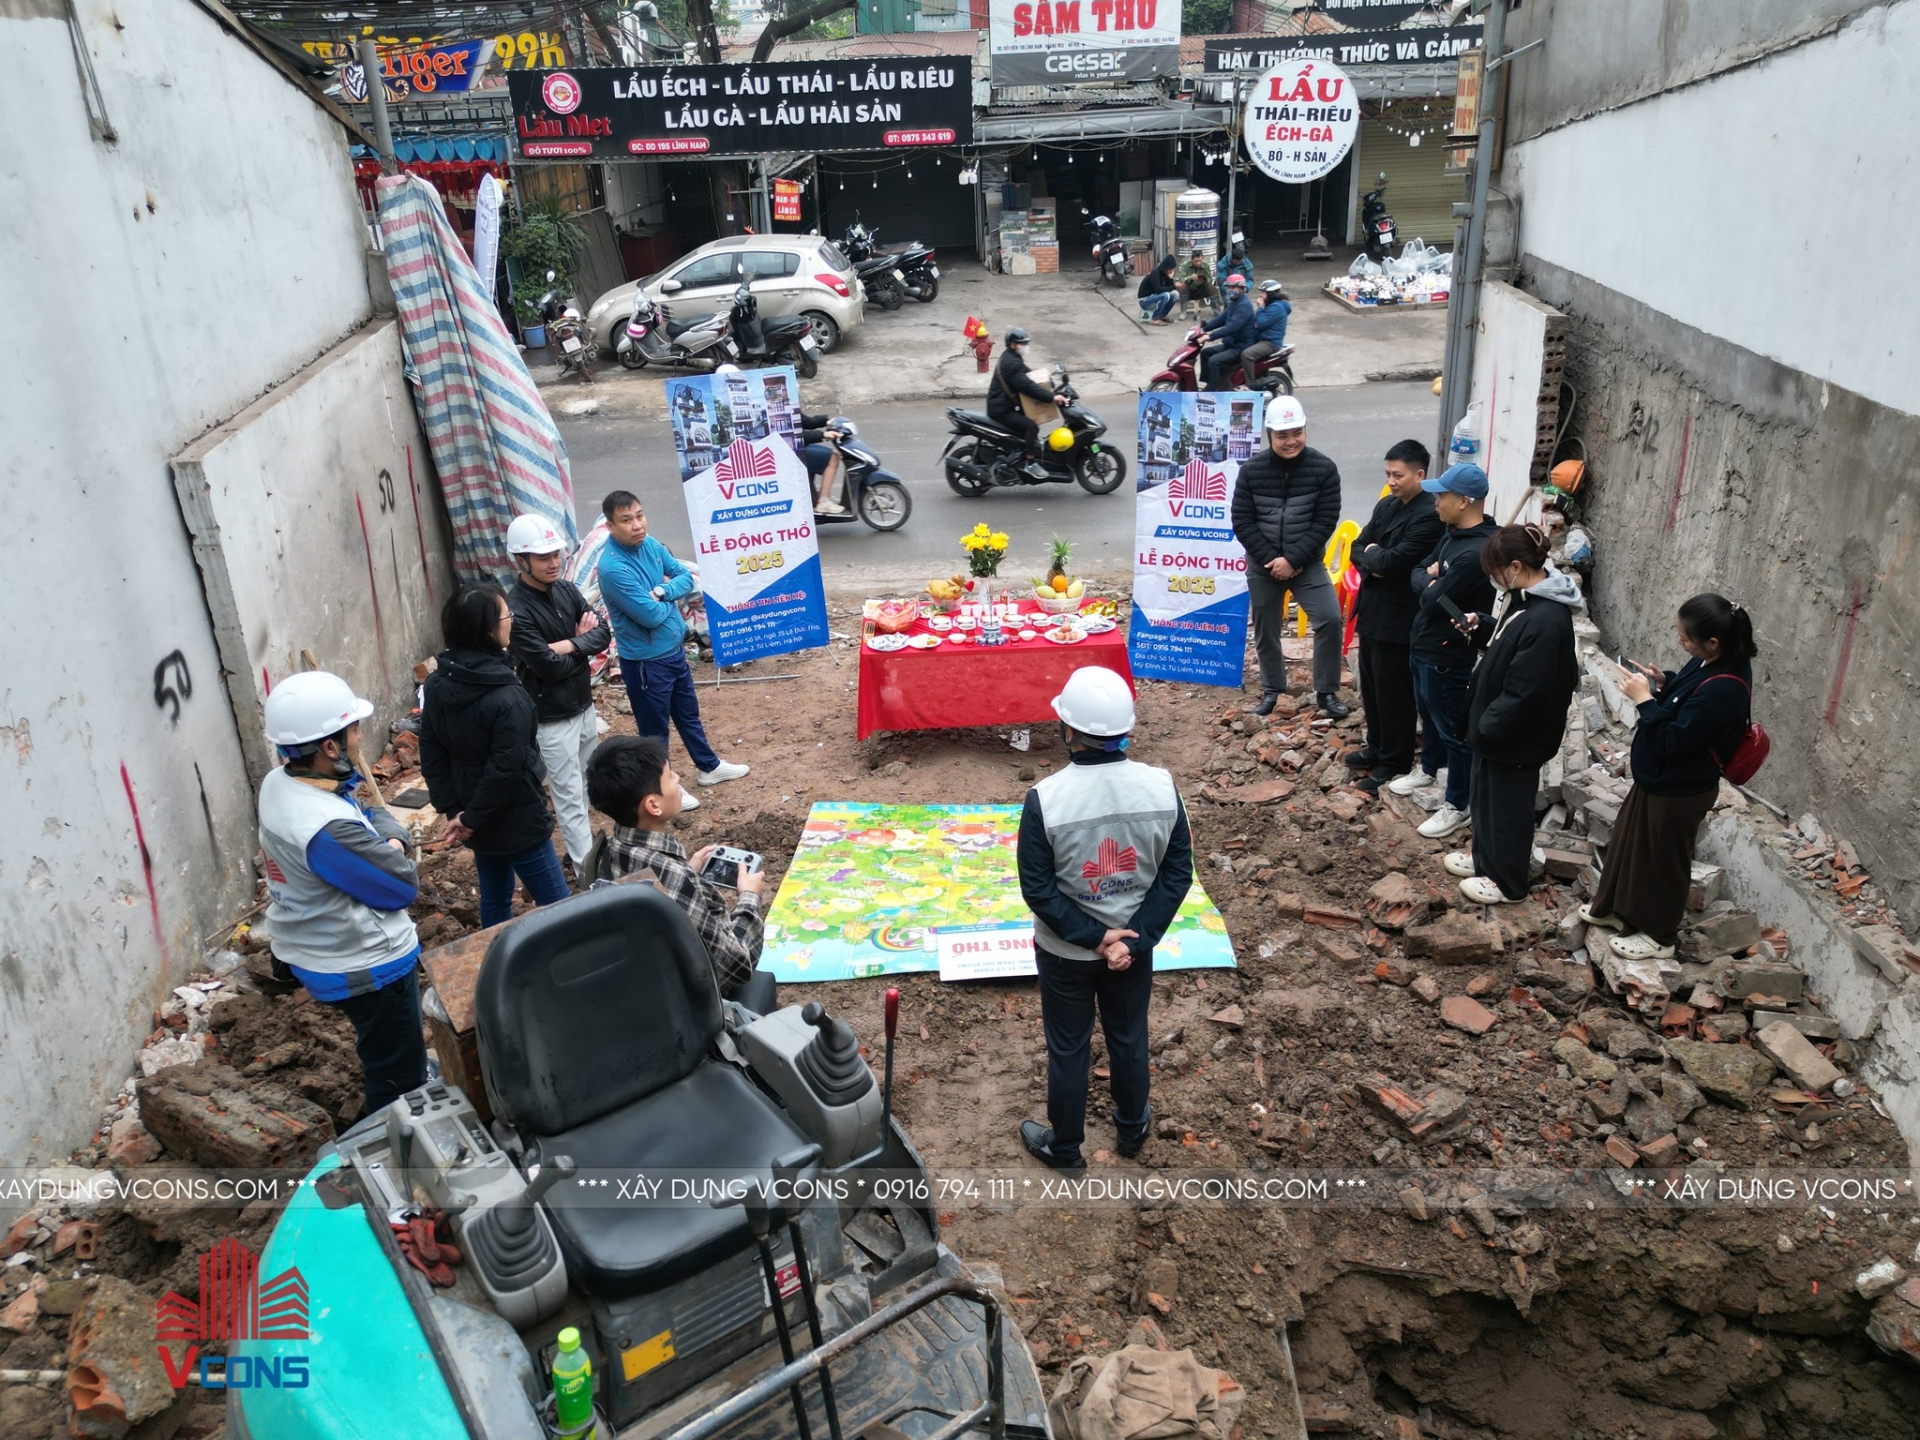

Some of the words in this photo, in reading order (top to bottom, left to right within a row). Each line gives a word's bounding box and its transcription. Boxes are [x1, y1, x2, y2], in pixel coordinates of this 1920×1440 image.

[1218, 46, 1254, 70] HÃY
[1339, 38, 1390, 63] THỨC
[1395, 36, 1420, 60] VÀ
[1424, 33, 1470, 58] CẢM
[375, 42, 469, 93] Tiger
[1045, 51, 1127, 73] caesar
[613, 71, 657, 99] LẨU
[662, 68, 707, 97] ẾCH
[724, 67, 770, 95] LẨU
[777, 69, 833, 94] THÁI
[850, 63, 896, 91] LẨU
[900, 66, 955, 89] RIÊU
[1267, 64, 1344, 102] LẨU
[665, 102, 709, 129] LẨU
[713, 103, 745, 126] GÀ
[760, 100, 805, 126] LẨU
[811, 101, 850, 124] HẢI
[855, 98, 902, 122] SẢN
[1254, 104, 1352, 122] THÁI-RIÊU
[518, 110, 564, 138] Lẩu
[566, 114, 613, 141] Mẹt
[1265, 122, 1333, 142] ẾCH-GÀ
[657, 142, 670, 150] 195
[690, 141, 706, 149] NAM
[888, 134, 899, 143] ĐT:
[901, 133, 919, 142] 0975
[922, 133, 936, 141] 343
[938, 132, 951, 141] 619
[1268, 148, 1283, 161] BÒ
[1293, 151, 1301, 161] H
[1304, 147, 1326, 163] SẢN
[718, 480, 779, 500] VCONS
[717, 510, 733, 520] XÂY
[735, 508, 759, 519] DỰNG
[760, 503, 787, 514] VCONS
[1168, 500, 1225, 519] VCONS
[700, 534, 720, 554] LỄ
[724, 532, 773, 551] ĐỘNG
[776, 521, 811, 542] THỔ
[1161, 526, 1177, 536] XÂY
[1202, 530, 1230, 539] VCONS
[735, 550, 785, 575] 2025
[1139, 548, 1157, 565] LỄ
[1161, 552, 1209, 570] ĐỘNG
[1167, 574, 1216, 595] 2025
[717, 616, 750, 628] Fanpage:
[751, 606, 806, 622] @xaydungvcons
[1149, 618, 1179, 629] THÔNG
[1195, 621, 1214, 632] LIÊN
[719, 630, 736, 639] SĐT:
[736, 626, 753, 635] 0916
[754, 623, 766, 631] 794
[1136, 631, 1169, 642] Fanpage:
[1169, 635, 1227, 647] @xaydungvcons
[1153, 643, 1169, 651] 0916
[154, 648, 193, 728] 50
[1088, 879, 1133, 894] VCONS
